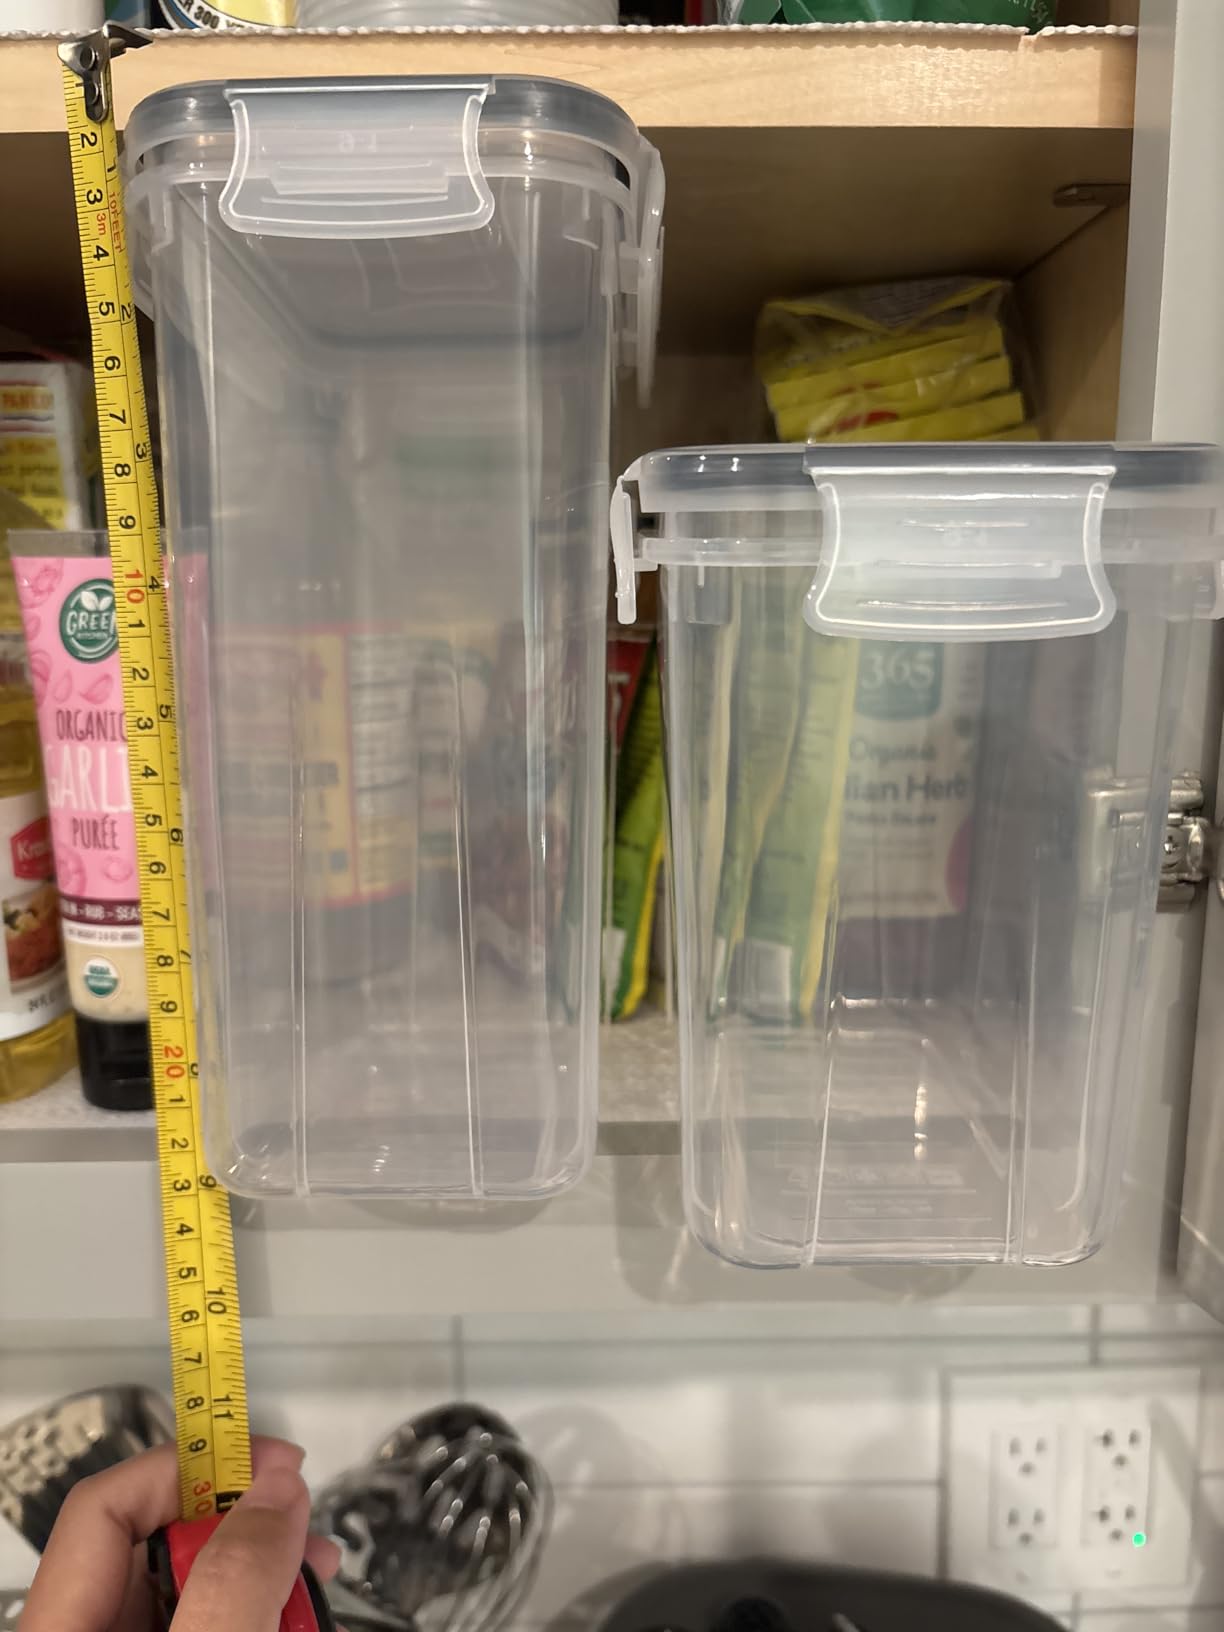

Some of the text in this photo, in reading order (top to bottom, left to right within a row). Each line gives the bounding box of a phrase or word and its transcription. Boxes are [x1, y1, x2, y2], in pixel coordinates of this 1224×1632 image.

[80, 131, 98, 149] 2
[86, 188, 103, 205] 3
[96, 212, 107, 236] 3m
[93, 245, 109, 261] 4
[98, 301, 114, 317] 5
[104, 355, 121, 371] 6
[109, 409, 127, 424] 7
[114, 463, 131, 478] 8
[119, 514, 136, 530] 9
[125, 569, 146, 604] 10
[128, 619, 146, 629] 1
[132, 666, 150, 681] 2
[136, 716, 154, 731] 3
[141, 765, 159, 779] 4
[145, 813, 162, 827] 5
[149, 861, 167, 875] 6
[152, 908, 170, 921] 7
[156, 954, 174, 967] 8
[160, 1000, 178, 1014] 9
[164, 1046, 185, 1079] 20
[169, 1094, 186, 1105] 1
[171, 1137, 189, 1149] 2
[173, 1179, 191, 1192] 3
[199, 1174, 217, 1188] 9
[176, 1223, 194, 1236] 4
[179, 1266, 197, 1280] 5
[206, 1287, 228, 1315] 10
[181, 1309, 200, 1323] 6
[184, 1352, 202, 1364] 7
[187, 1396, 204, 1410] 8
[188, 1438, 207, 1453] 9
[193, 1481, 214, 1513] 30
